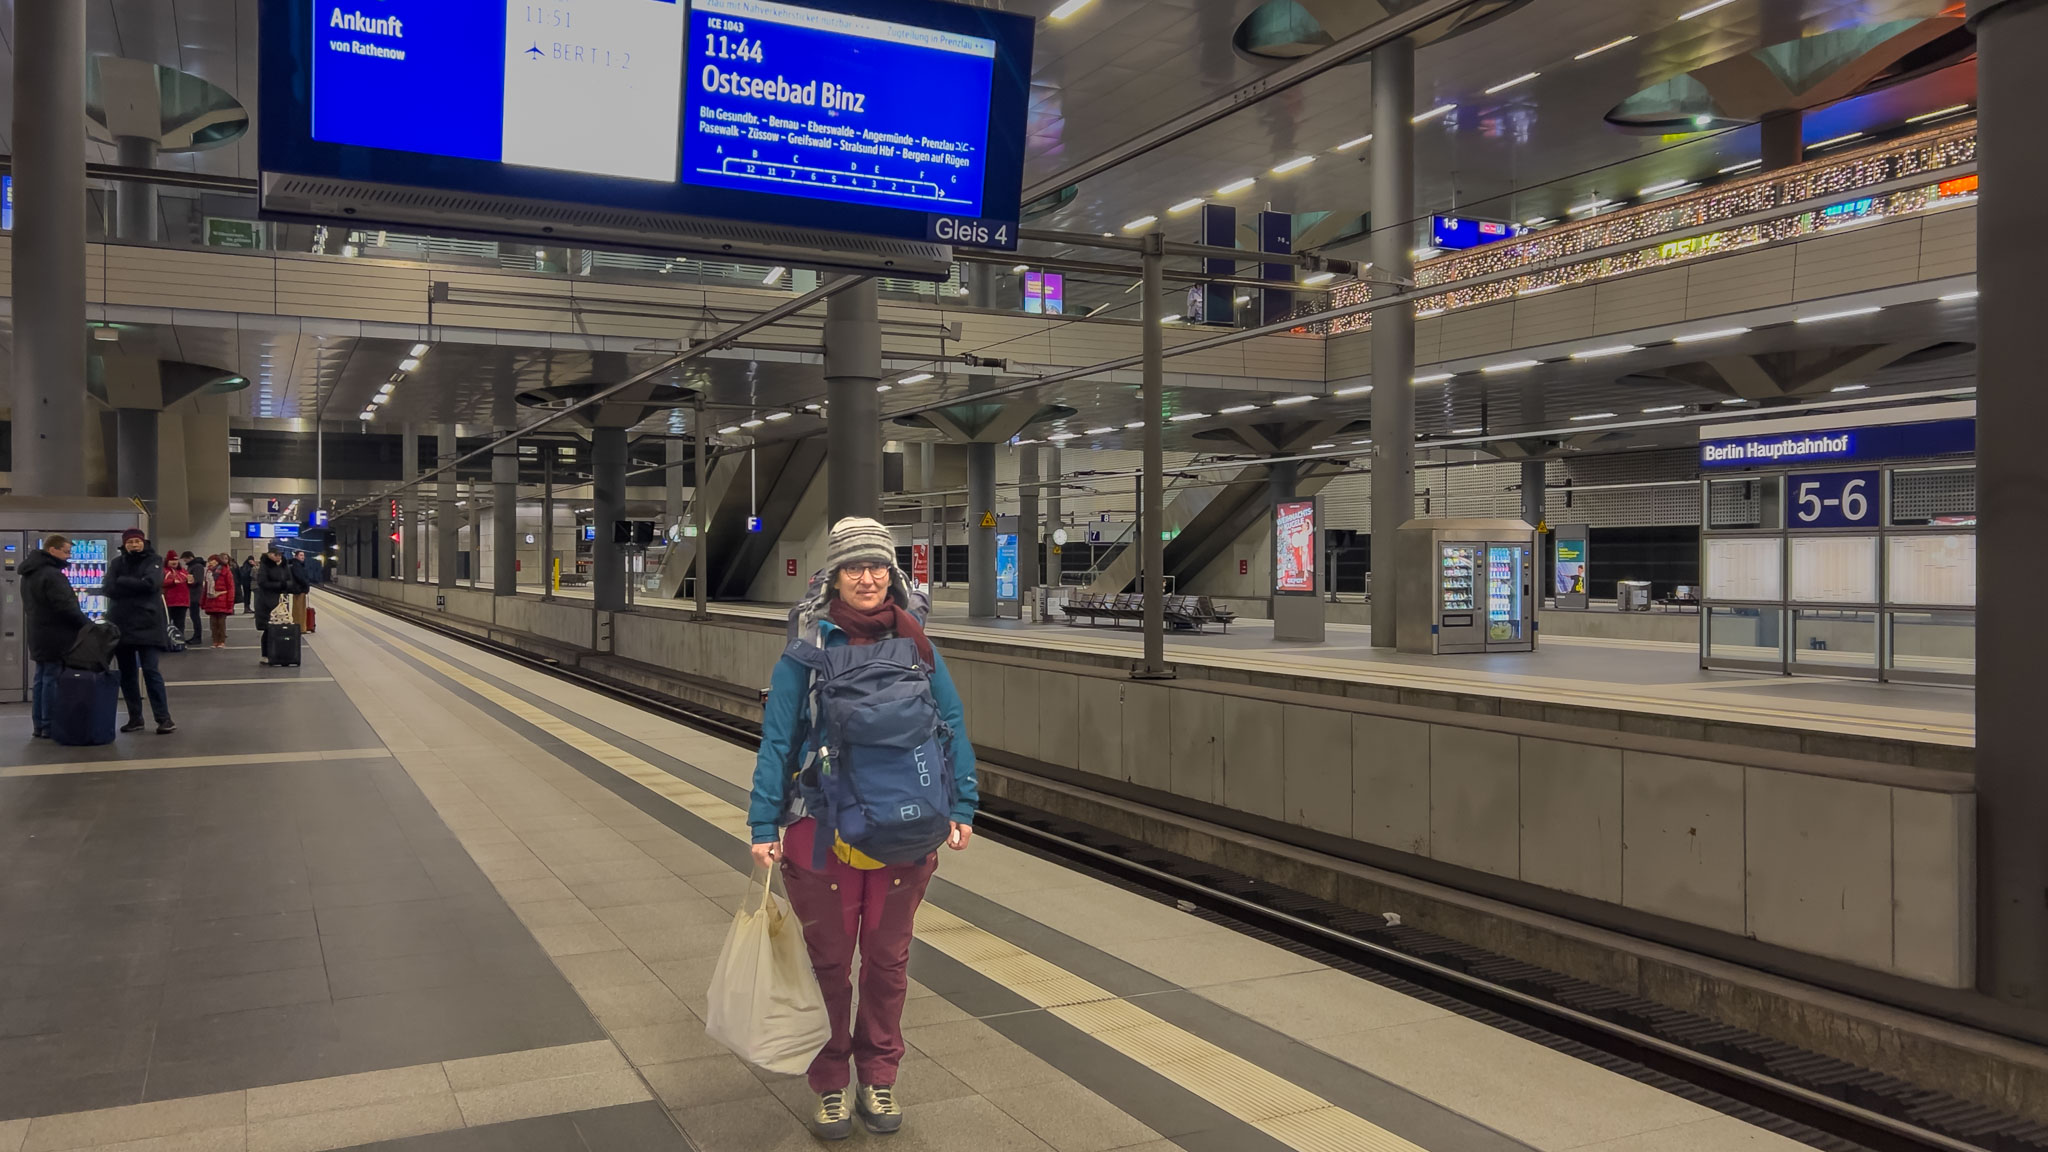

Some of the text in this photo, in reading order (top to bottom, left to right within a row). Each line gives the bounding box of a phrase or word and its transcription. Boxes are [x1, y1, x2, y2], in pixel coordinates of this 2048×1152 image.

[330, 7, 403, 38] Ankunft
[527, 5, 570, 28] 11:51
[708, 17, 744, 33] ICE 1043
[743, 2, 818, 22] Nahverkehrsticket
[821, 16, 852, 29] nutzbar
[705, 33, 763, 63] 11:44
[888, 26, 972, 49] Zugteilung in Prenzlau
[330, 40, 406, 61] von Rathenow
[553, 42, 584, 63] BER
[702, 64, 864, 113] Ostseebad Binz
[700, 105, 954, 152] Bln Gesundbr. Bernau Eberswalde Angermünde Prenzlau
[699, 120, 970, 168] Pasewalk Züssow Greifswald Stralsund Hbf Bergen auf Rügen
[717, 145, 957, 183] A B C D E F G
[747, 165, 755, 173] 12
[768, 167, 776, 176] 11
[791, 170, 796, 178] 7
[811, 172, 816, 181] 6
[831, 175, 837, 183] 5
[872, 180, 877, 188] 3
[935, 218, 1008, 245] Gleis 4
[1443, 217, 1458, 230] 1-6
[1705, 435, 1848, 461] Berlin Hauptbahnhof
[272, 501, 279, 511] 4
[1798, 479, 1868, 522] 5-6
[316, 510, 327, 525] F
[747, 517, 757, 530] F
